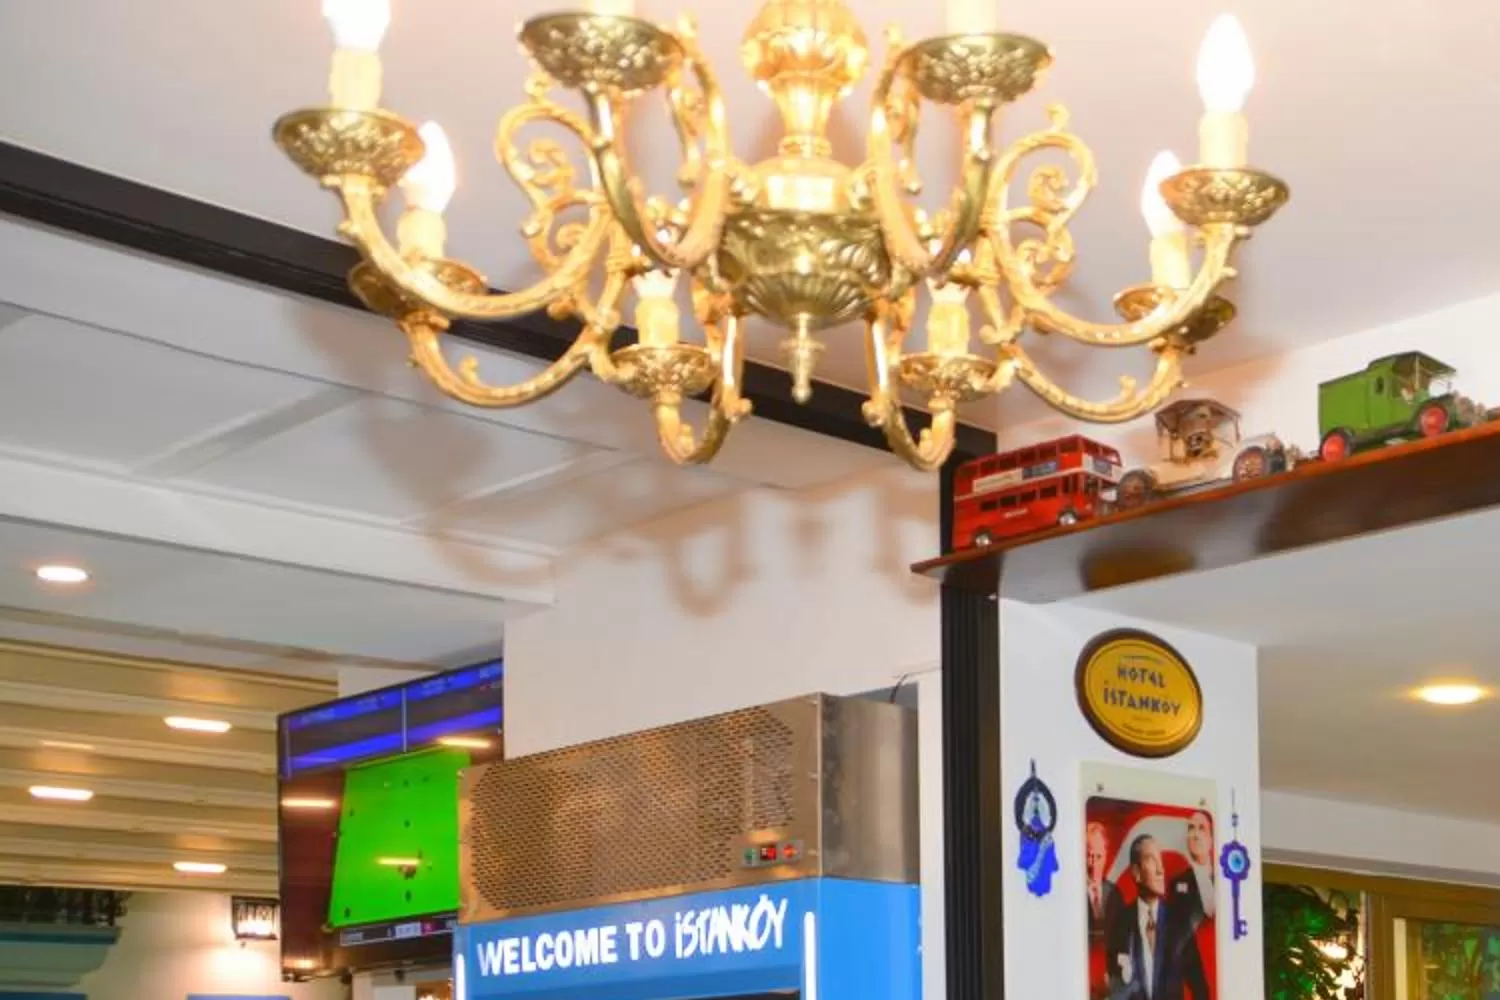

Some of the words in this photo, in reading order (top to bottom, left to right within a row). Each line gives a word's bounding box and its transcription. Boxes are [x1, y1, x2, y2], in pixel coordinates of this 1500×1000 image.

[1117, 666, 1167, 689] HOTEL
[477, 925, 618, 976] WELCOME
[625, 920, 665, 961] TO
